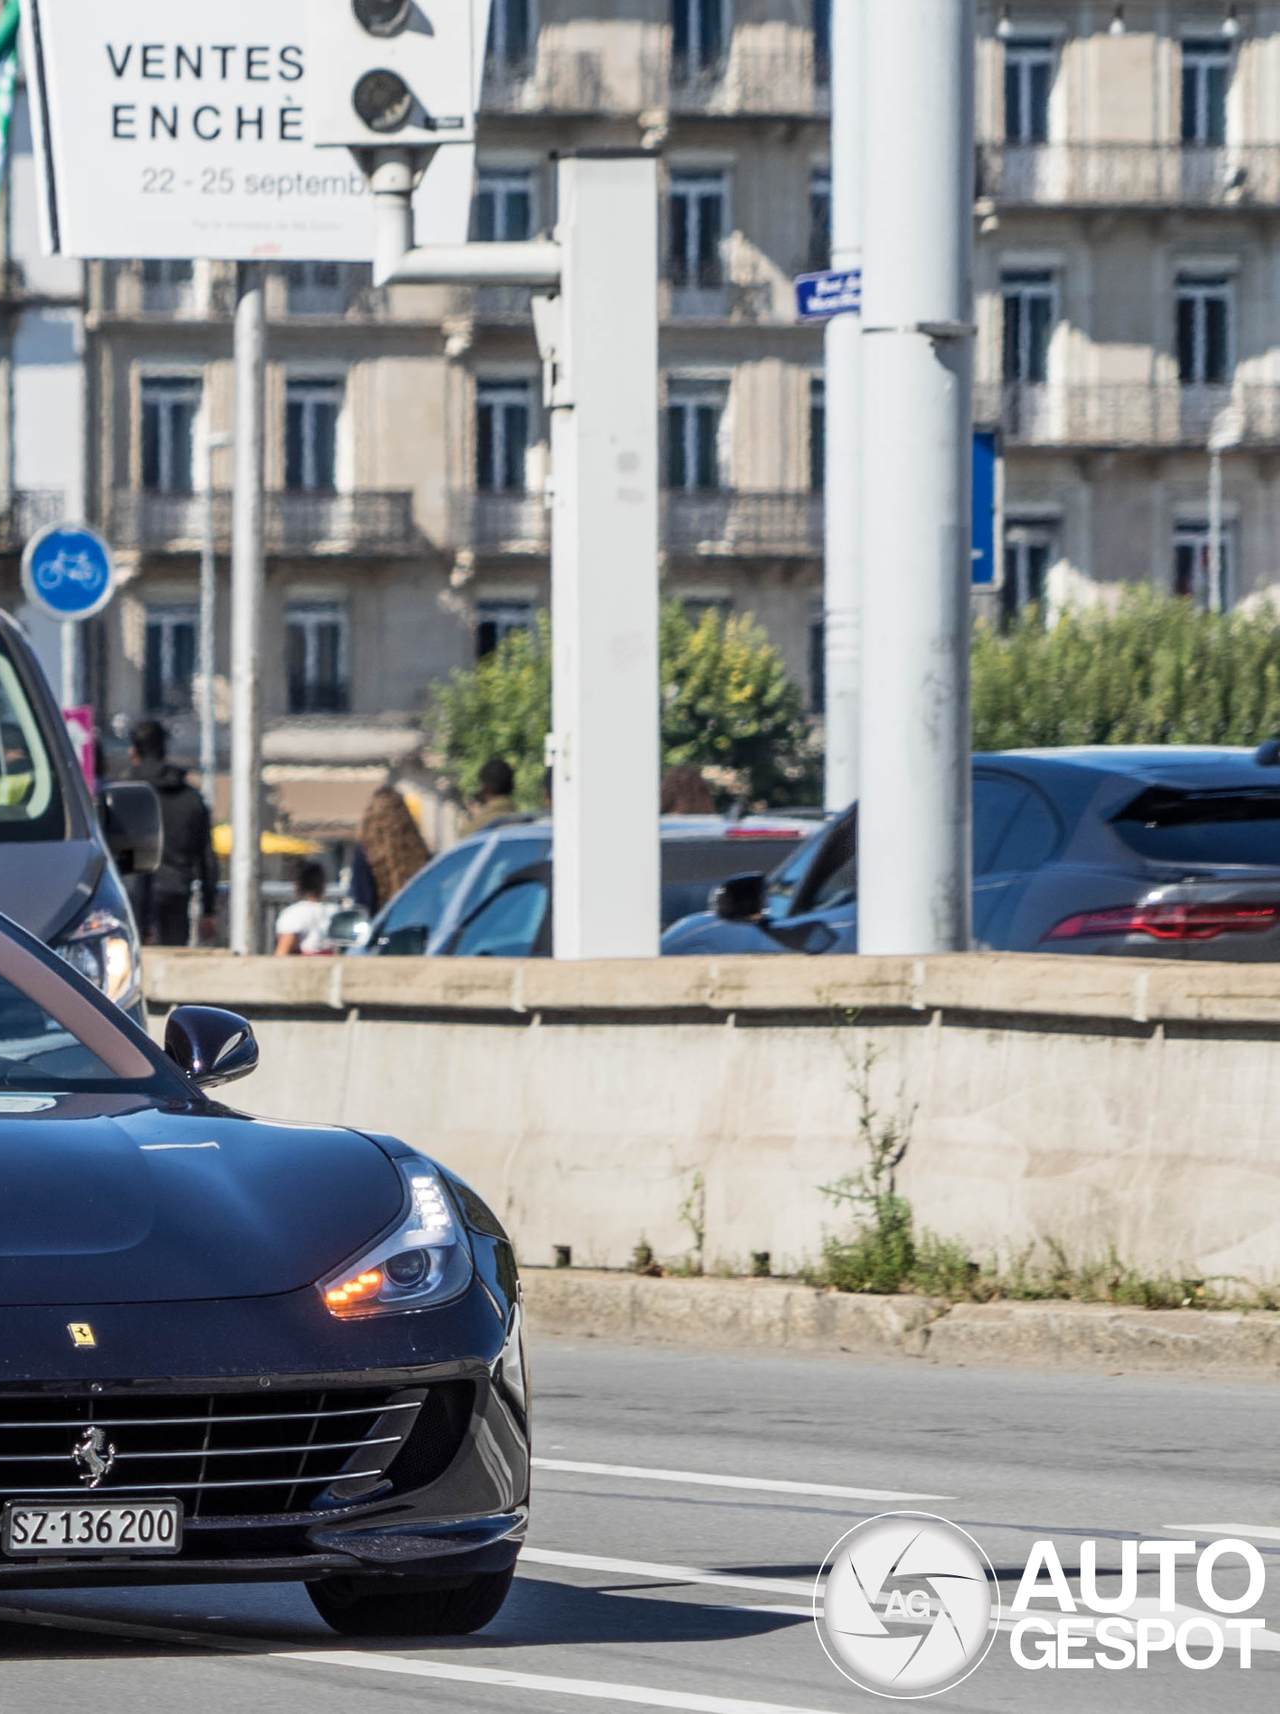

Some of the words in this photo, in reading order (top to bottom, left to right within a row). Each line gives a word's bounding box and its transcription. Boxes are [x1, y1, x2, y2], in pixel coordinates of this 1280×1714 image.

[106, 44, 304, 81] VENTES
[112, 95, 303, 141] ENCHÈ
[142, 169, 175, 194] 22
[200, 169, 235, 194] 25
